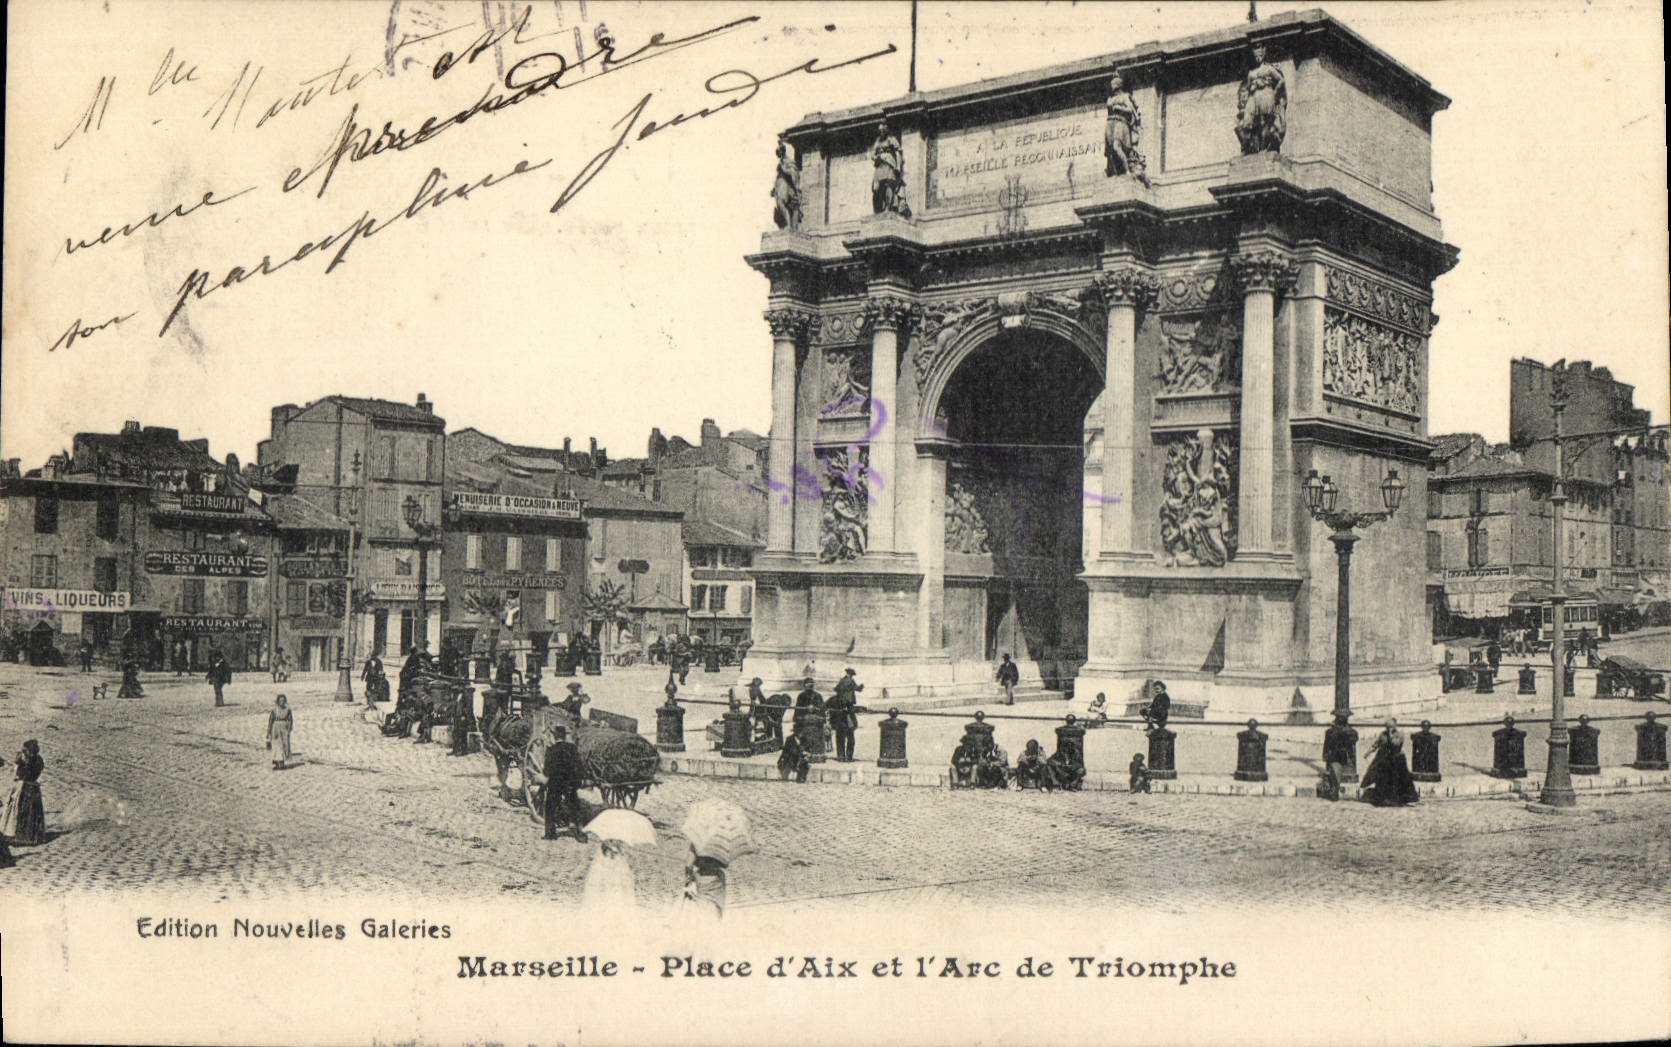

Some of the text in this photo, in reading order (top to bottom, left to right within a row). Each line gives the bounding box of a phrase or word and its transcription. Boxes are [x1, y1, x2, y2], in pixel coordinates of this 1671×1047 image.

[182, 493, 243, 510] RESTAURANT
[557, 500, 579, 512] NEUVE
[163, 552, 252, 567] RESTAURANT
[175, 565, 241, 574] DES ALPES
[11, 591, 126, 608] VINS LIQUEURS
[165, 618, 248, 628] RESTAURANT
